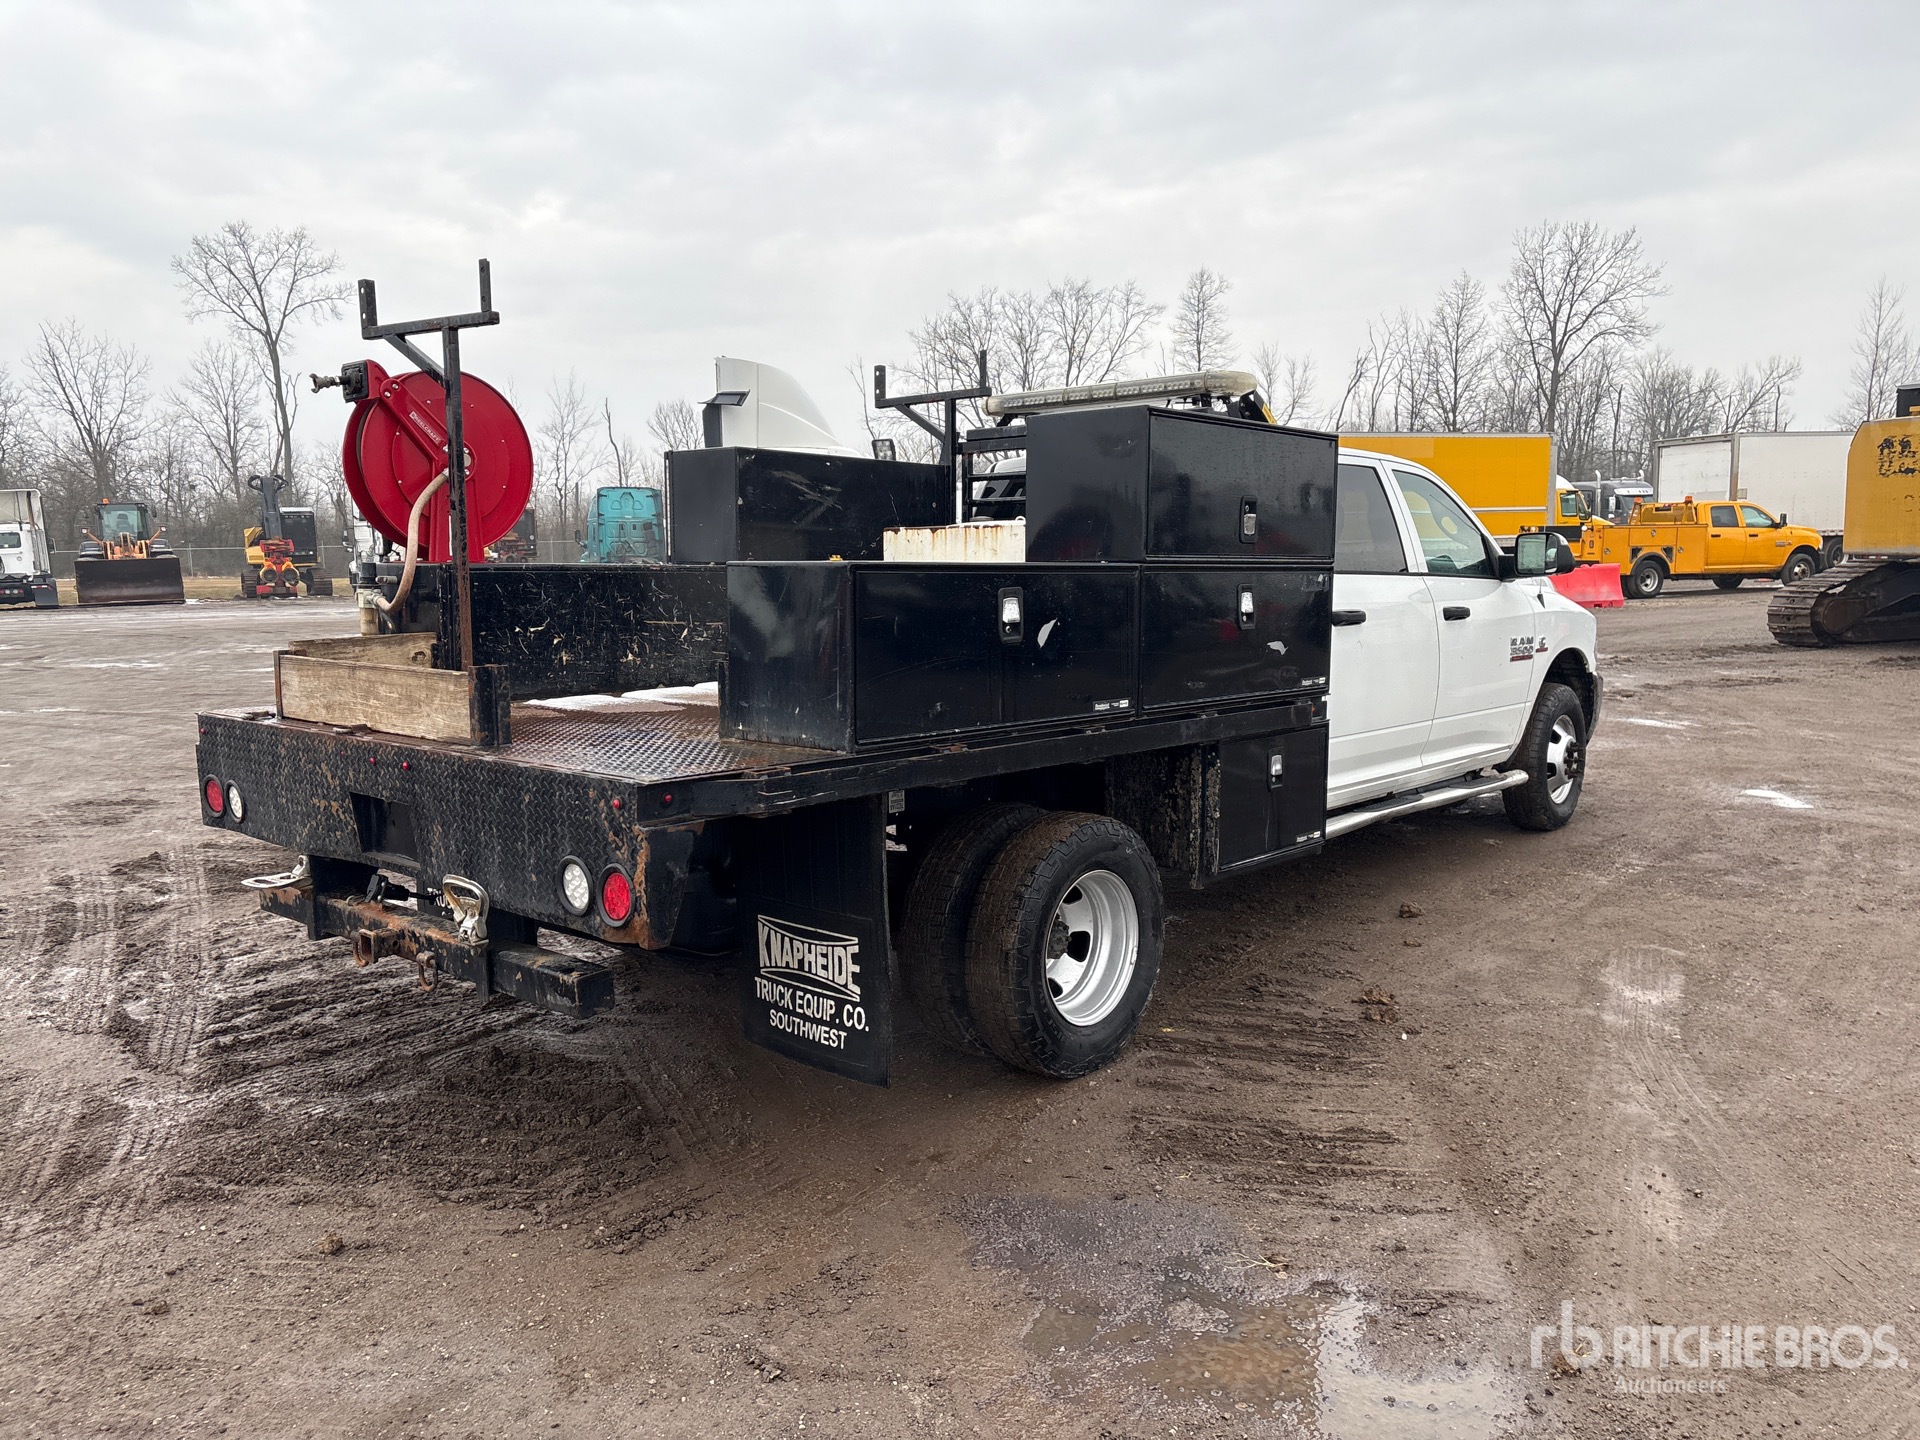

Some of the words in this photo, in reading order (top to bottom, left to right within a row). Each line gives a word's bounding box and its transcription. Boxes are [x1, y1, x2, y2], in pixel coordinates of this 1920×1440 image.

[1510, 636, 1534, 646] RAM
[757, 921, 861, 995] KNAPHEIDE
[754, 976, 793, 1010] TRUCK
[843, 1005, 870, 1032] CO.
[769, 1009, 847, 1049] SOUTHWEST
